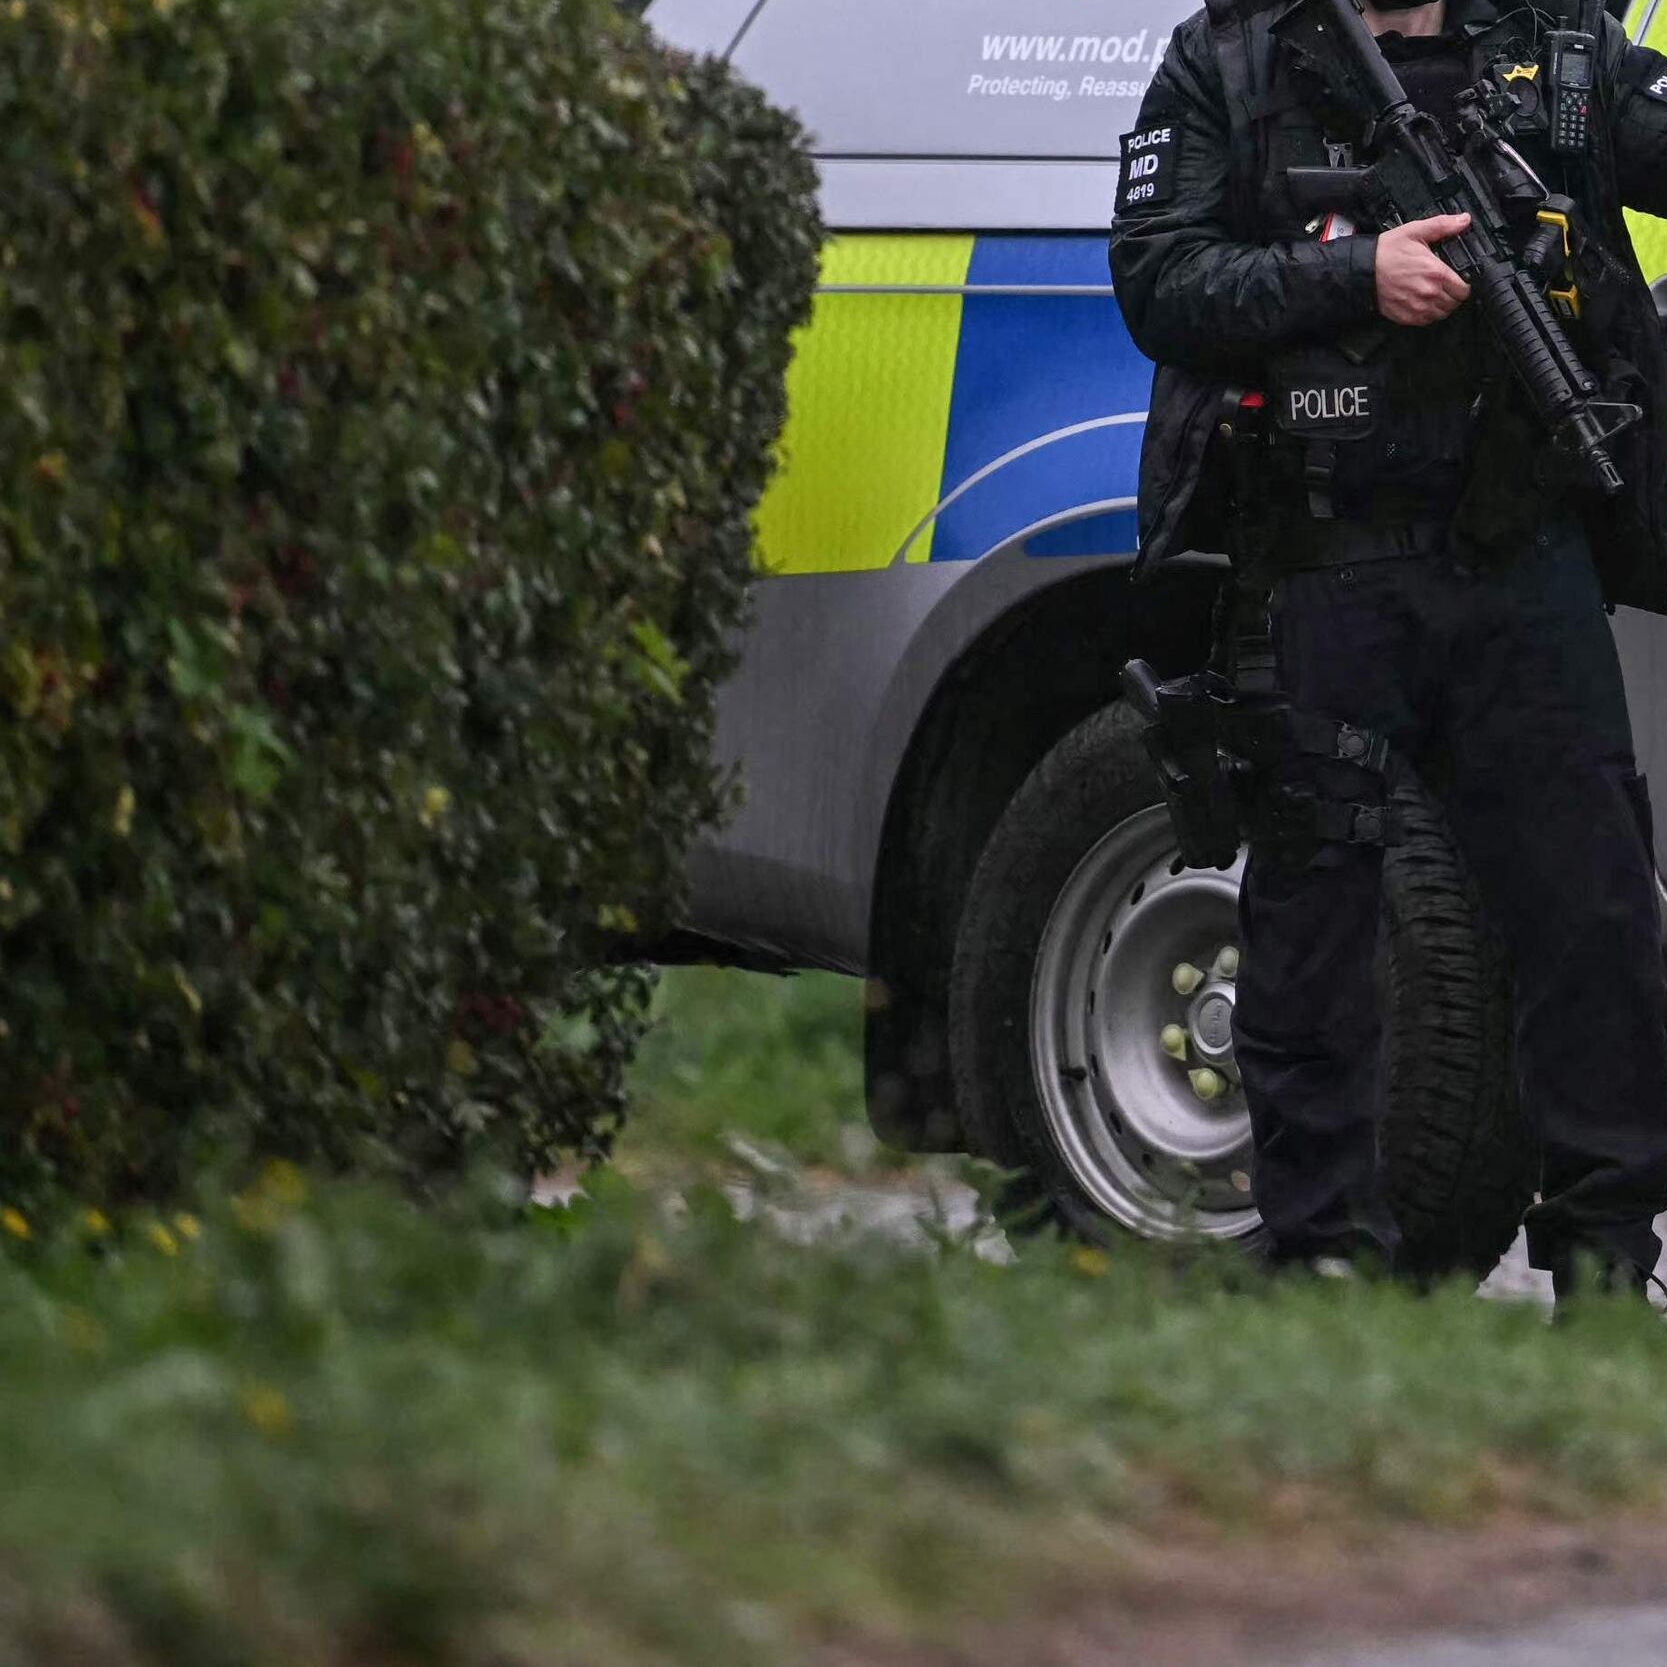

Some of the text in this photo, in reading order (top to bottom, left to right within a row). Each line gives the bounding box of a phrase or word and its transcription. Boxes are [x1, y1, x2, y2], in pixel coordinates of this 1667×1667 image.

[967, 74, 1072, 101] Protecting,
[1127, 128, 1171, 153] POLICE
[1128, 154, 1159, 180] MD
[1126, 183, 1155, 205] 4819
[1290, 386, 1370, 420] POLICE
